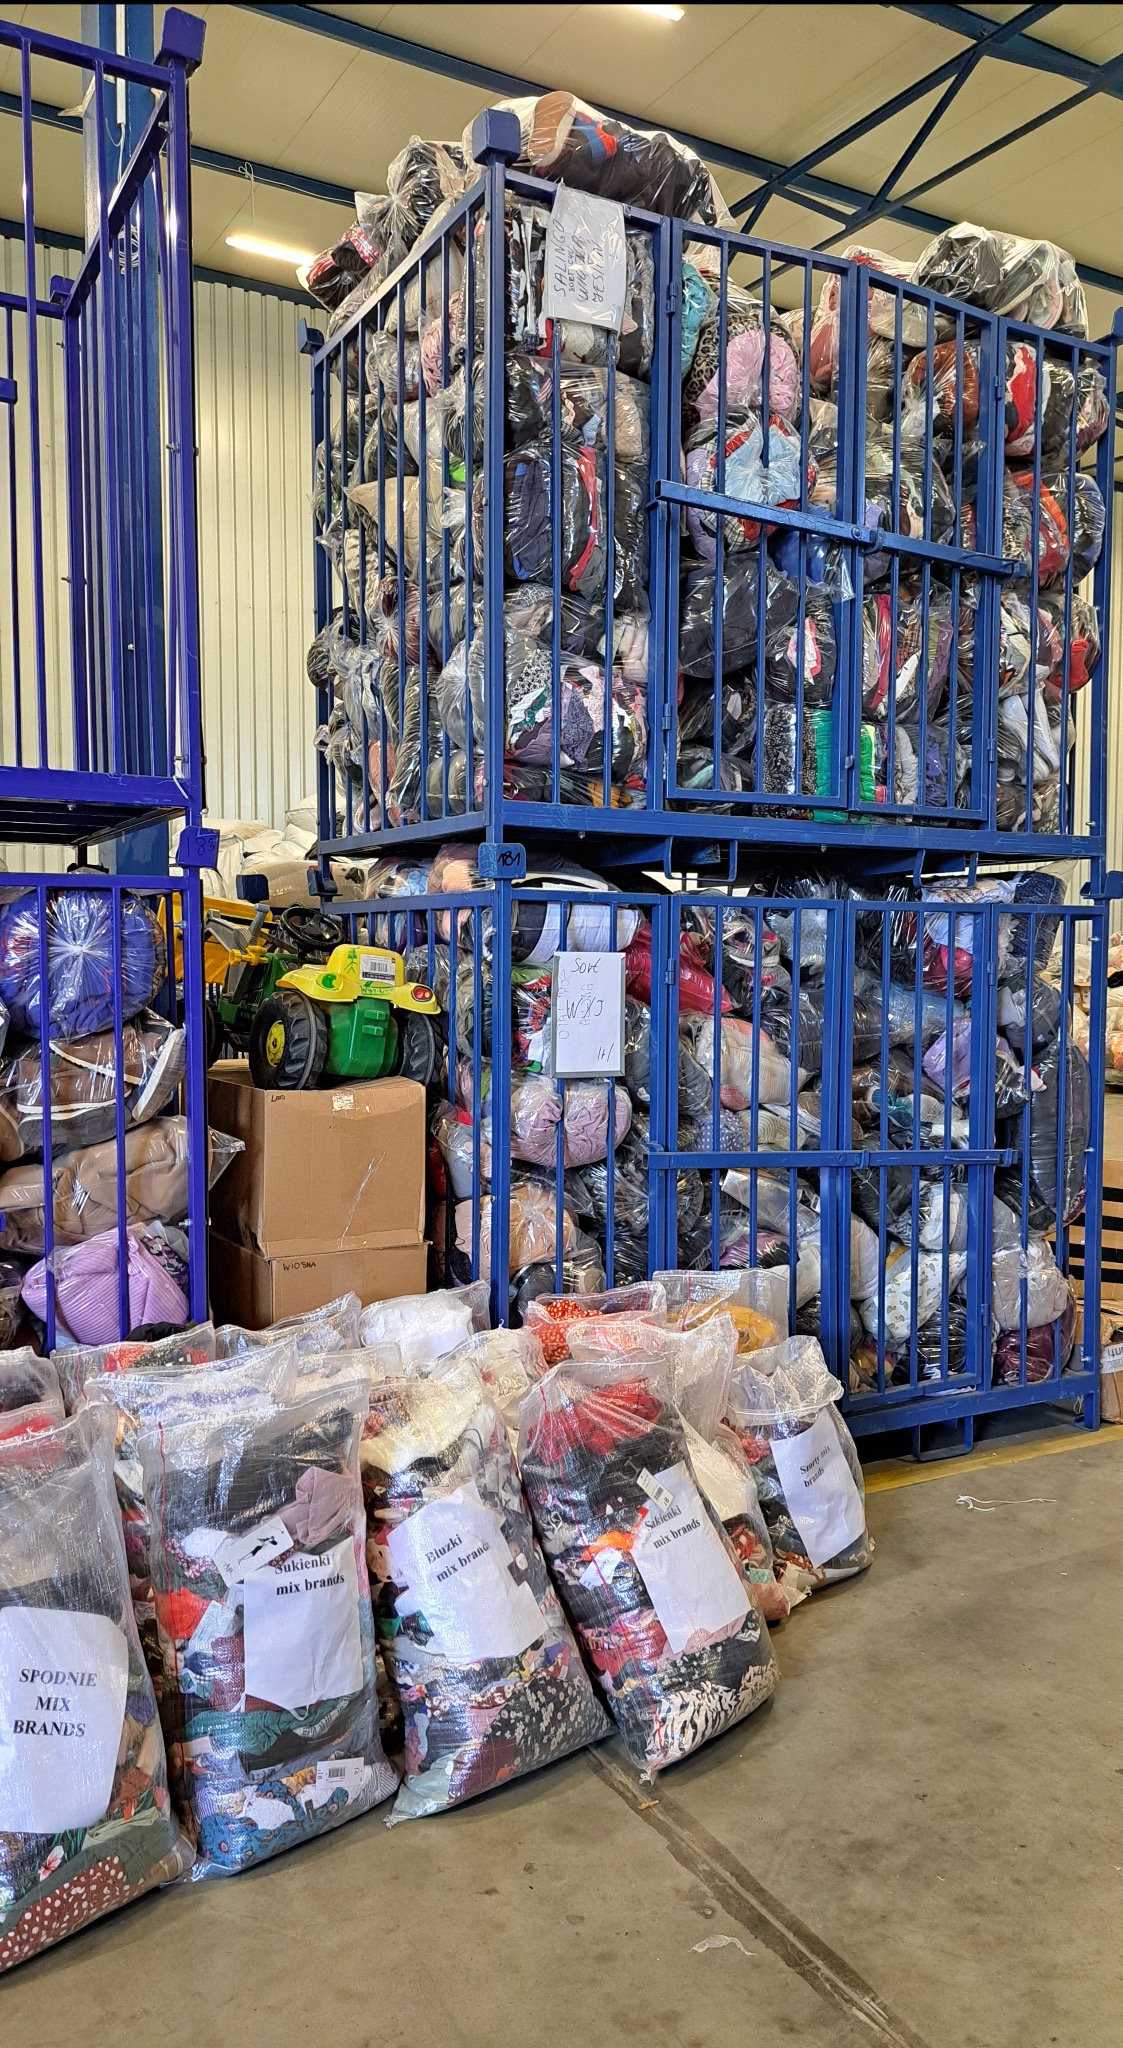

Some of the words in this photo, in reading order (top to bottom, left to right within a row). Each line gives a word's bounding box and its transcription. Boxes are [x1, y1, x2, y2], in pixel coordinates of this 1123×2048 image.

[187, 837, 215, 856] 183
[497, 851, 521, 867] 181
[571, 957, 602, 974] Sort
[282, 1261, 317, 1271] WIOSNA
[652, 1535, 672, 1549] mix
[669, 1518, 702, 1540] brands
[424, 1533, 464, 1565] Bluzki
[274, 1554, 331, 1575] Sukienki
[436, 1563, 458, 1583] mix
[276, 1581, 301, 1596] mix
[304, 1573, 345, 1591] brands
[19, 1668, 98, 1687] SPODNIE
[35, 1696, 71, 1712] MIX
[12, 1719, 86, 1738] BRANDS
